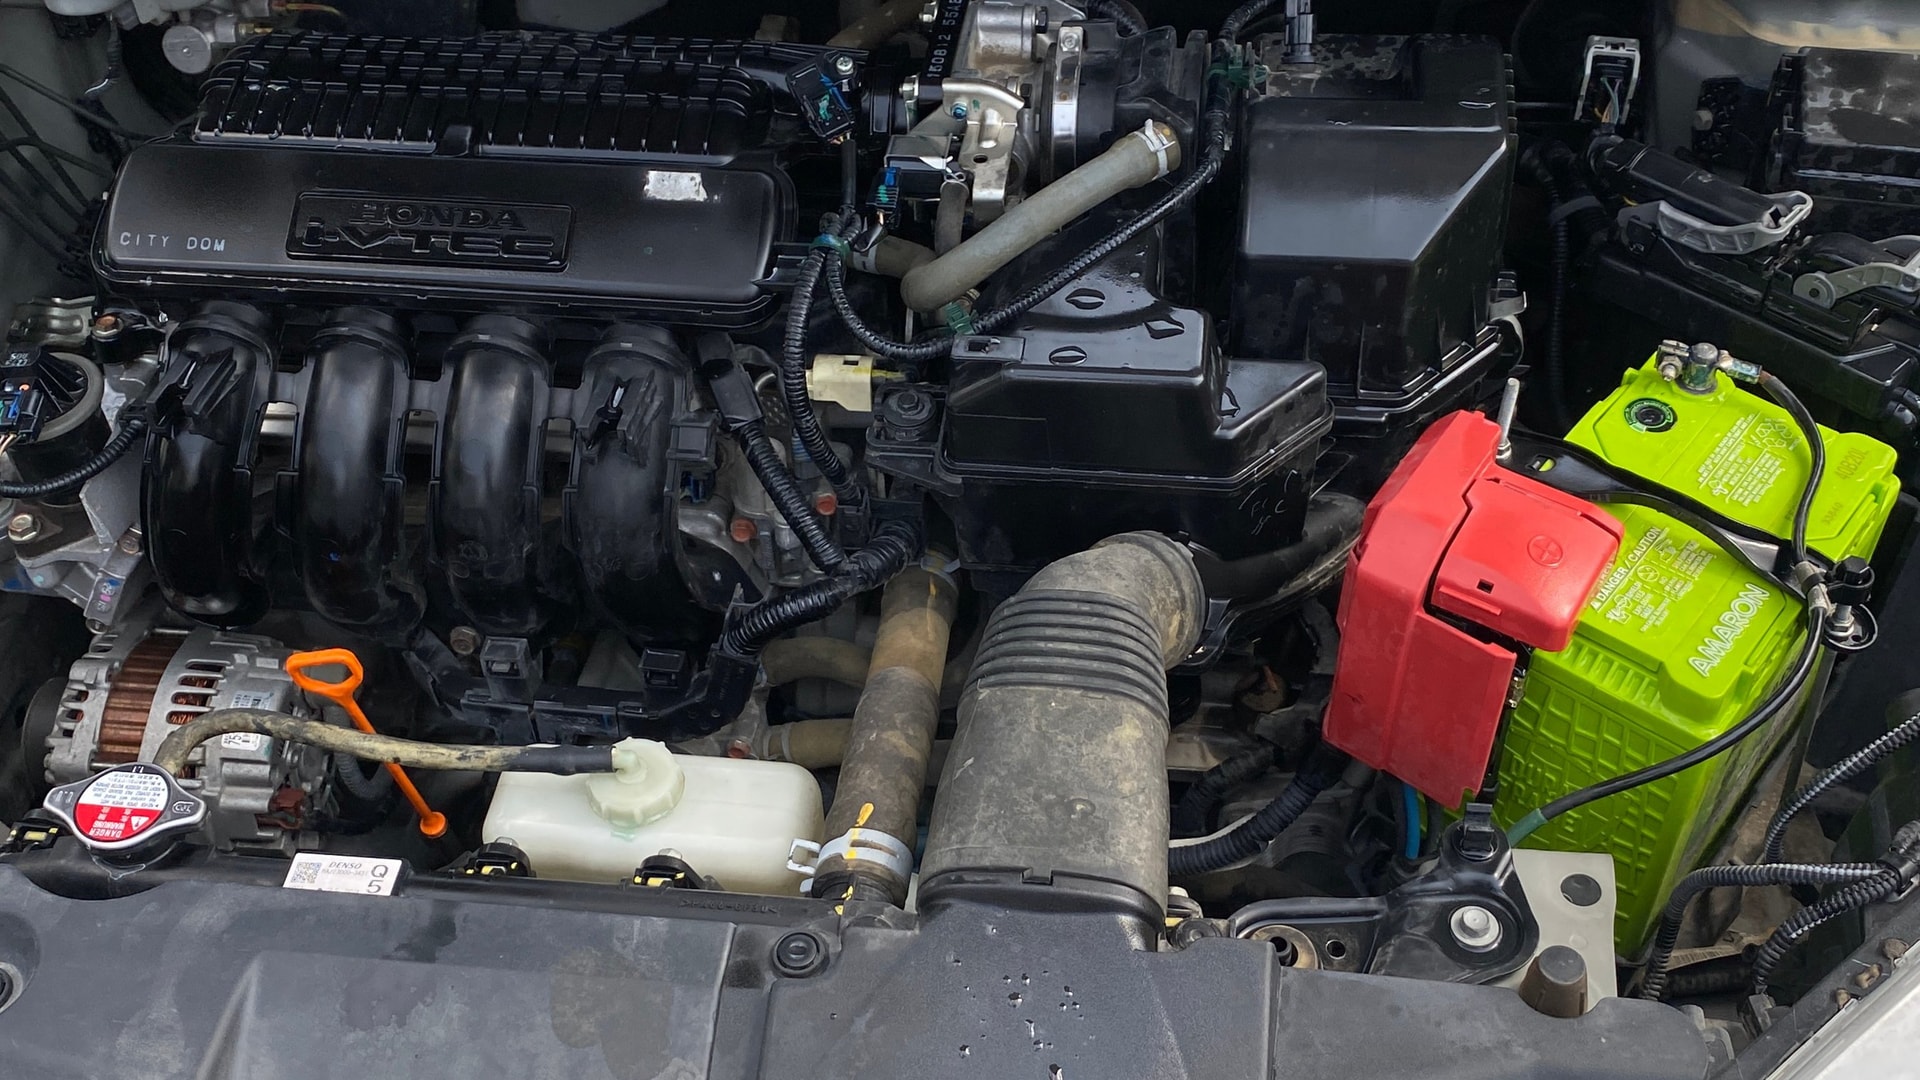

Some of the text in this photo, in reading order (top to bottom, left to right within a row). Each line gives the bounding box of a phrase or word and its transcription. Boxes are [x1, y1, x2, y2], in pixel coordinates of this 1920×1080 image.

[349, 202, 528, 232] HONDA
[120, 231, 226, 252] CITY DOM
[1596, 566, 1628, 600] DANGER
[1627, 528, 1660, 561] CAUTION
[1688, 582, 1770, 677] AMARON
[88, 827, 122, 839] DANGER
[328, 861, 363, 870] DENSO
[371, 864, 388, 879] Q
[366, 879, 384, 893] 5
